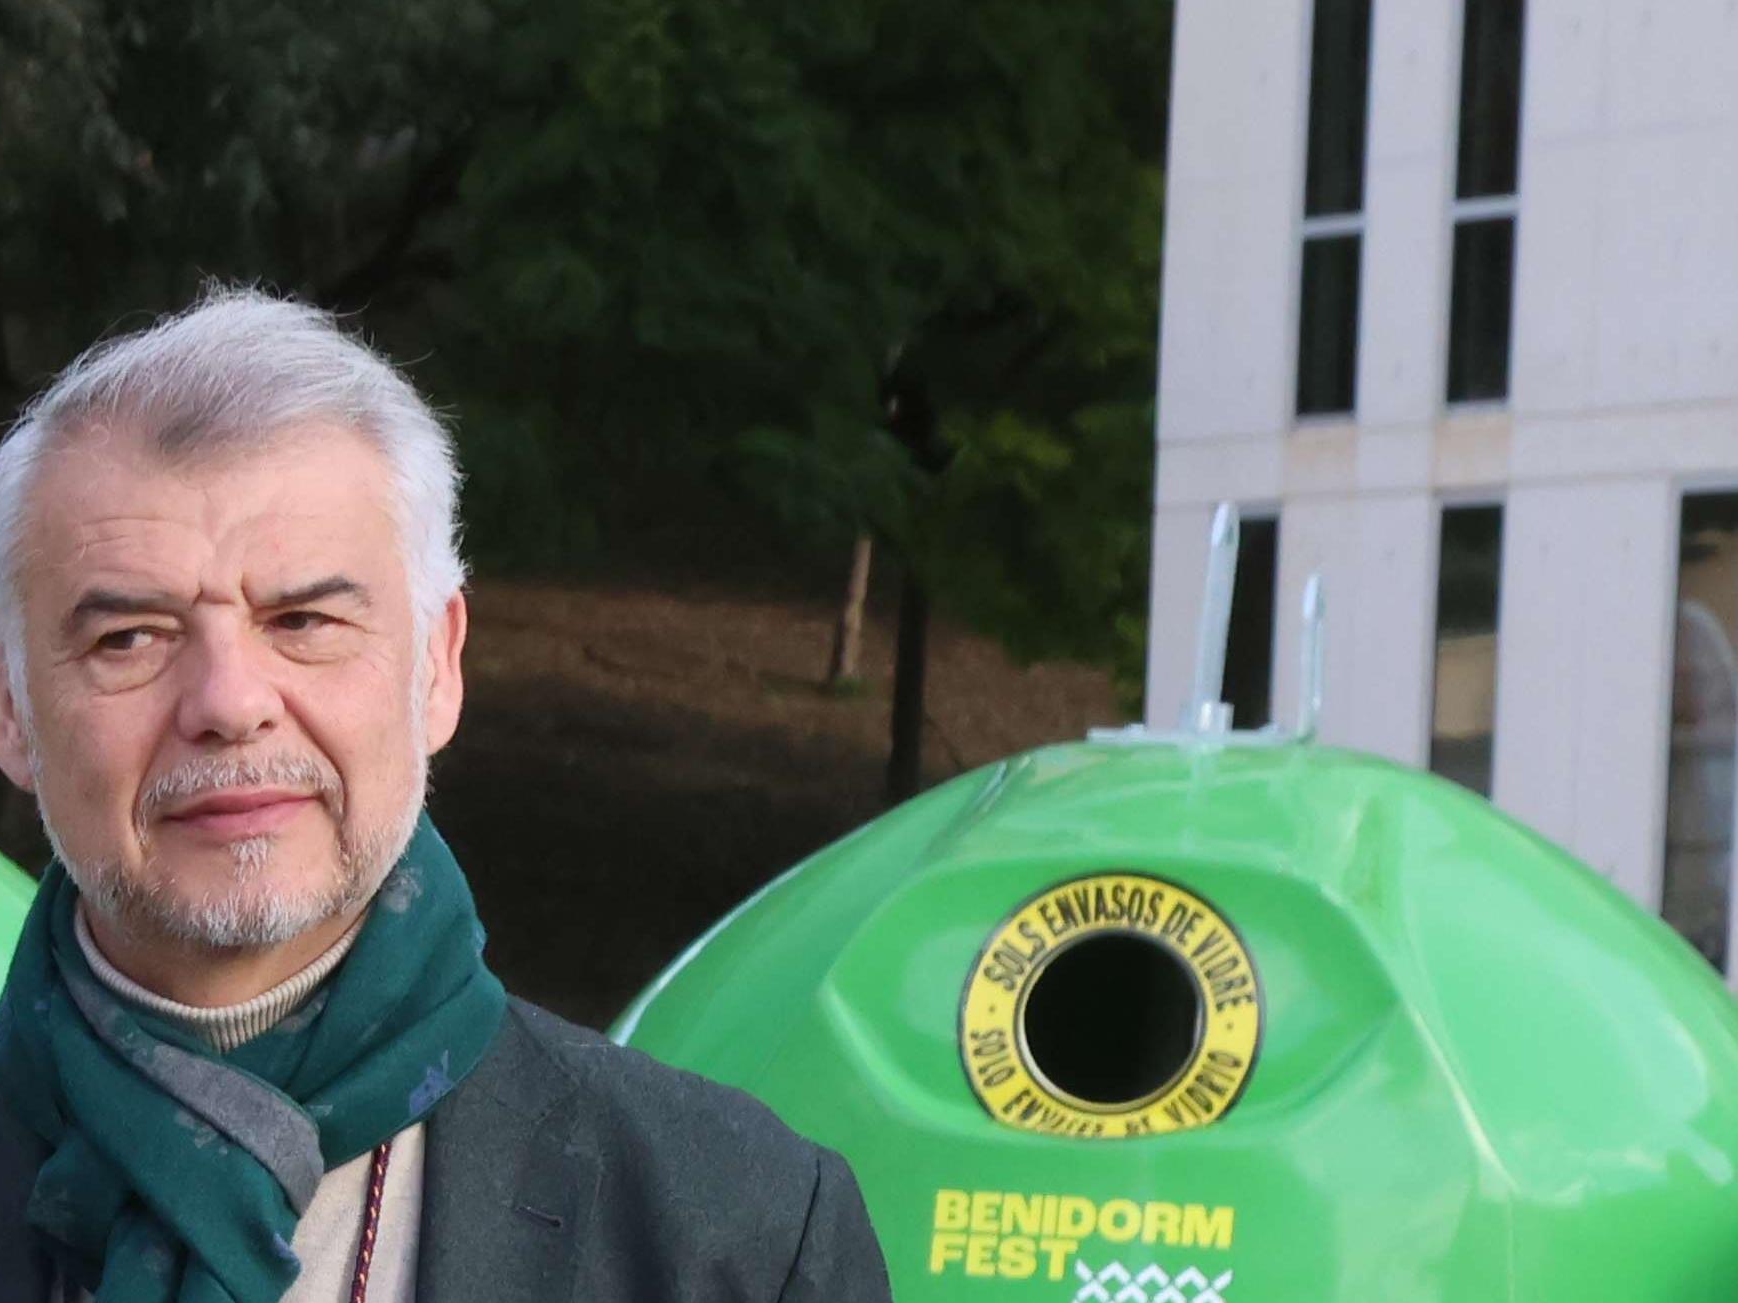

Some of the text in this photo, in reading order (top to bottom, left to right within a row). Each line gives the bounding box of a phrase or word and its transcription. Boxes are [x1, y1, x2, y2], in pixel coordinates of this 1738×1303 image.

[984, 884, 1254, 1013] SOLS ENVASOS DE VIDRE
[970, 1029, 1016, 1088] SOLO
[1163, 1050, 1242, 1127] VIDRIO
[929, 1232, 1079, 1282] FEST
[933, 1189, 1235, 1249] BENIDORM
